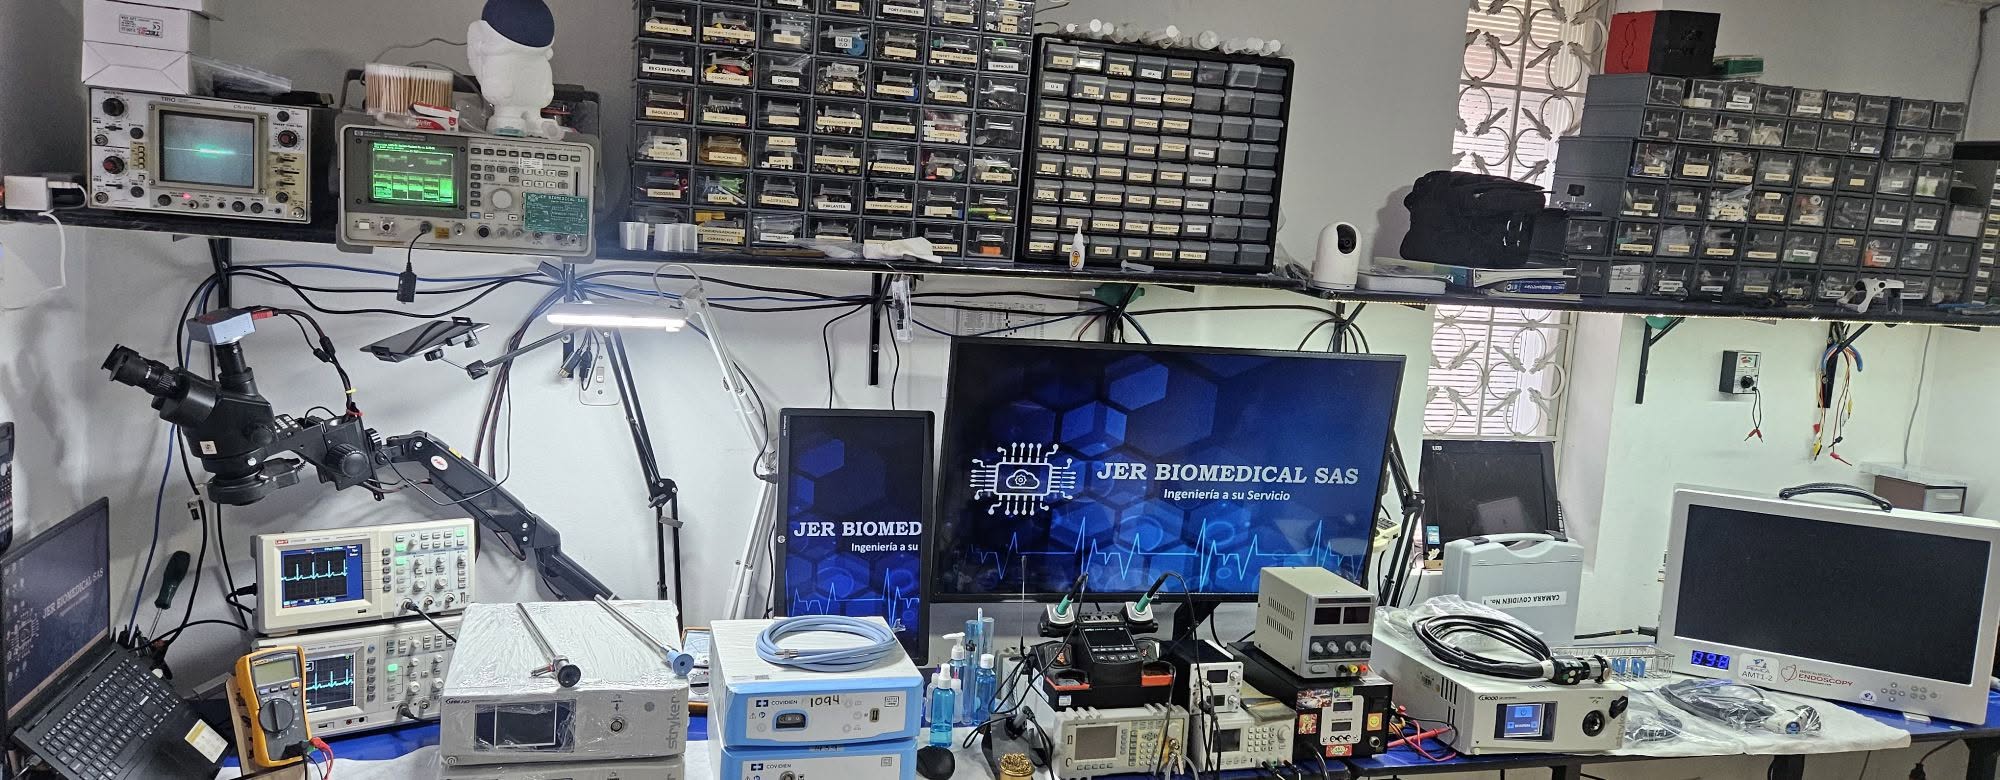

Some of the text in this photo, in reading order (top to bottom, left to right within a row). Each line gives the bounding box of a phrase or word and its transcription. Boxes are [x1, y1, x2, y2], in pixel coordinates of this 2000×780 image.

[648, 65, 687, 74] BOBINAS
[1096, 462, 1359, 485] JER BIOMEDICAL SAS
[1163, 488, 1291, 501] Ingeniería a su Servicio
[793, 521, 922, 537] JER BIOMED
[851, 541, 919, 553] Ingeniería a su
[42, 602, 56, 619] JER
[56, 576, 92, 609] BIOMEDICAL
[1502, 597, 1531, 605] COVIDIEN
[1798, 673, 1854, 686] ENDOSCOPY
[810, 694, 840, 708] 1094
[665, 696, 681, 750] stryker
